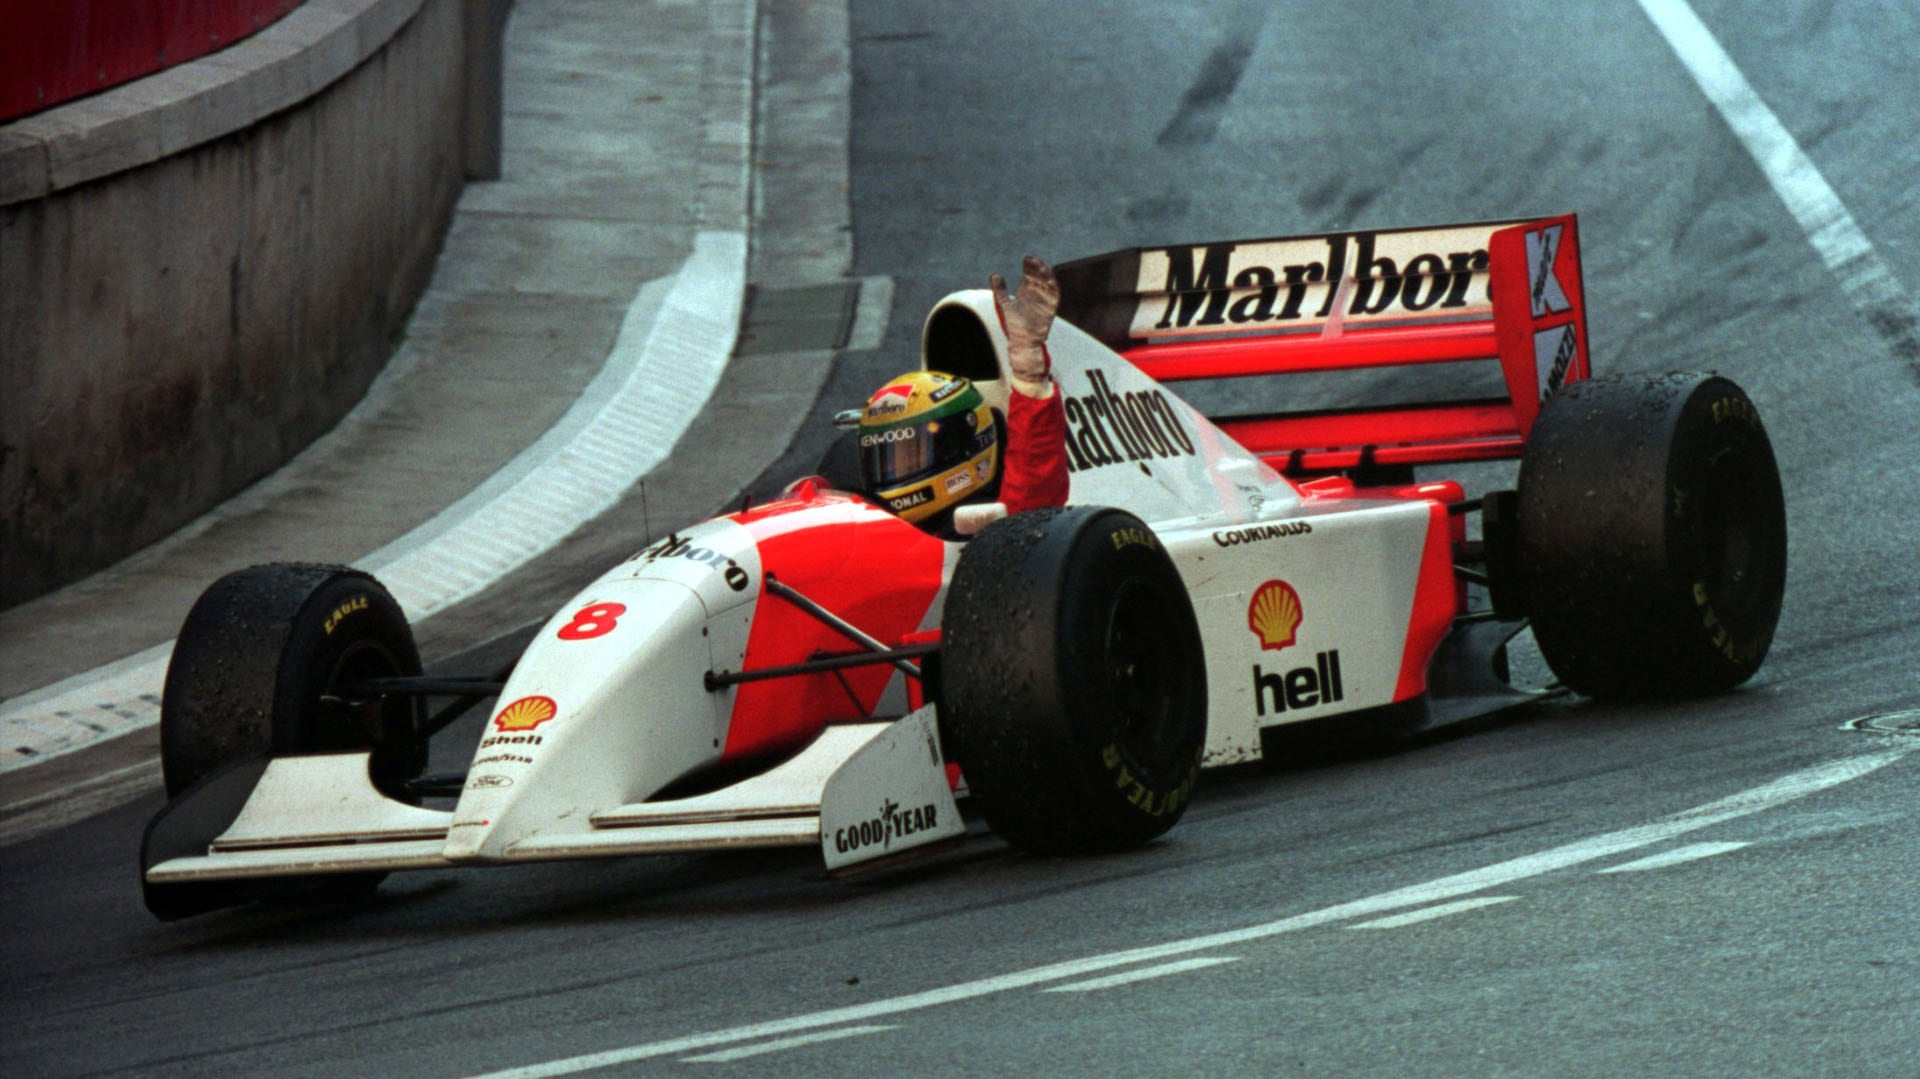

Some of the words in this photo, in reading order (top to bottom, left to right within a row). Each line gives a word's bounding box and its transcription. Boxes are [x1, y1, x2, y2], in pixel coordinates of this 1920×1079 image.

[1155, 232, 1494, 329] Marlbor
[868, 400, 906, 418] Marlboro
[1213, 520, 1312, 548] COURTAULDS
[324, 596, 369, 636] EAGLE
[556, 602, 627, 641] 8
[1253, 649, 1343, 717] hell
[481, 734, 543, 749] Shell
